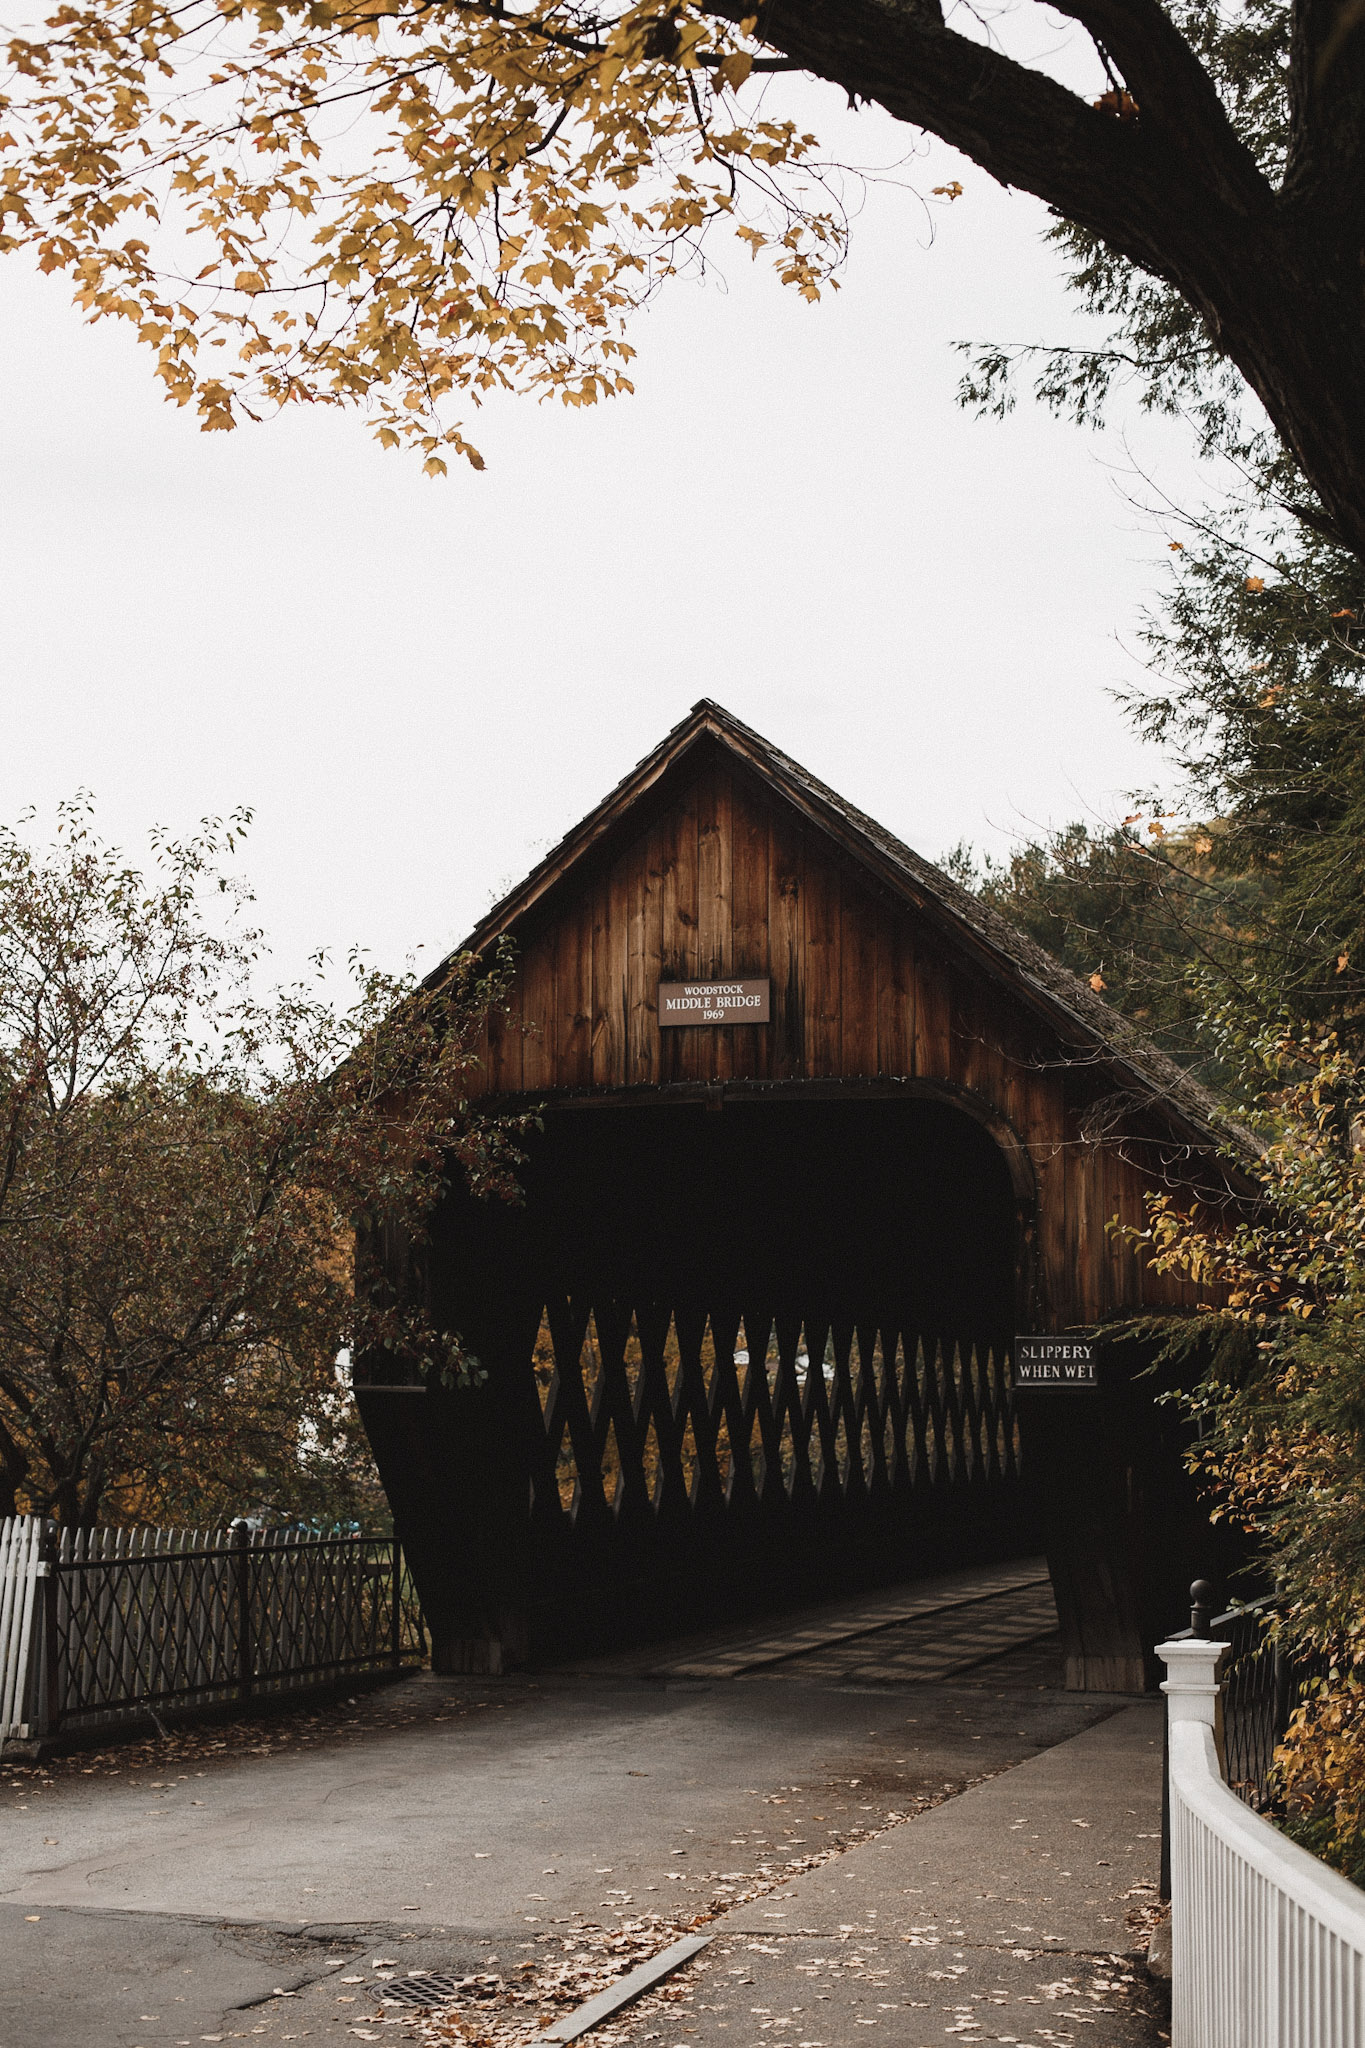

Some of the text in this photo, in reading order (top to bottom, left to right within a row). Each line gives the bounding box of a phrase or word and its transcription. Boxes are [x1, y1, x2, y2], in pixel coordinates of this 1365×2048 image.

[684, 985, 743, 995] WOODSTOCK
[666, 996, 761, 1010] MIDDLE BRIDGE
[703, 1009, 724, 1020] 1969
[1021, 1346, 1093, 1359] SLIPPERY
[1020, 1365, 1095, 1378] WHEN WET
